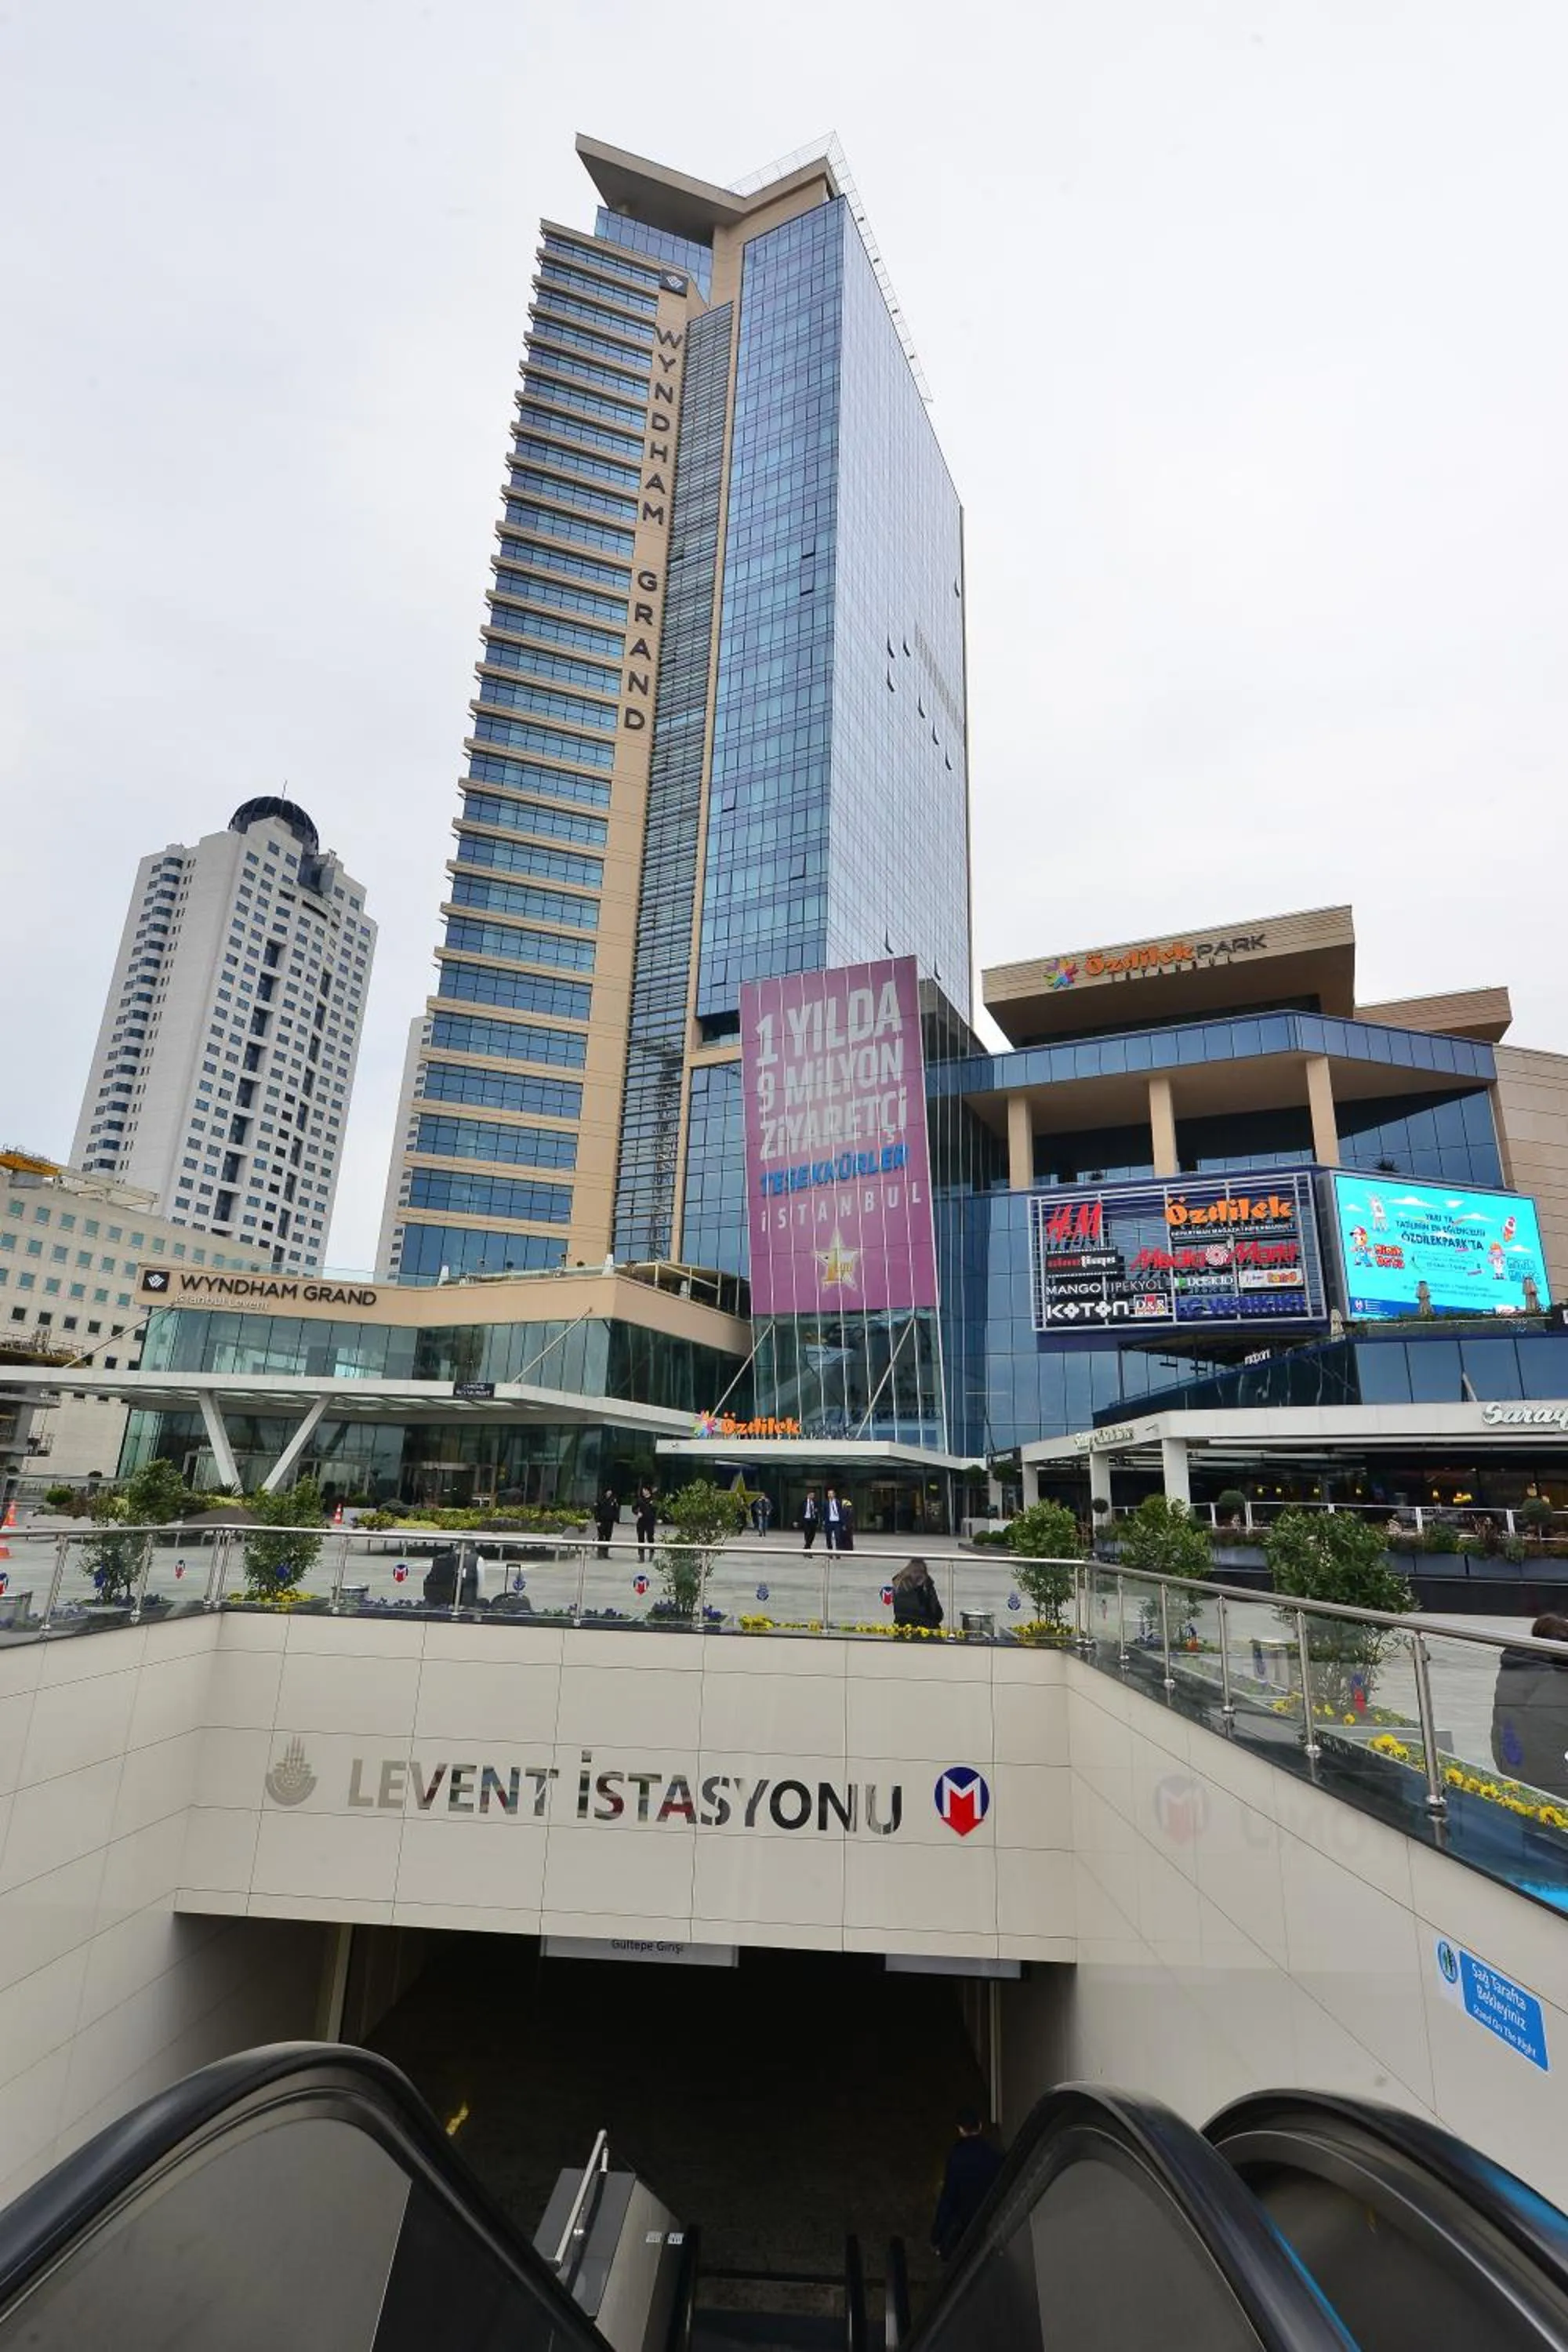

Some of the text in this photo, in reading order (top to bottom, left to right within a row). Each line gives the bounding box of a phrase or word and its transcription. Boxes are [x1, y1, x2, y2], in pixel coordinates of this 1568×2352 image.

[624, 325, 683, 731] WYNDHAM GRAND
[755, 981, 902, 1066] 1 YILDA
[757, 1072, 775, 1114] 9
[1045, 1201, 1102, 1242] H&M
[1166, 1195, 1293, 1225] Özdilek
[180, 1273, 377, 1307] WYNDHAM GRAND
[1046, 1283, 1101, 1294] MANGO
[721, 1412, 801, 1435] Özdilek
[347, 1759, 560, 1817] LEVENT
